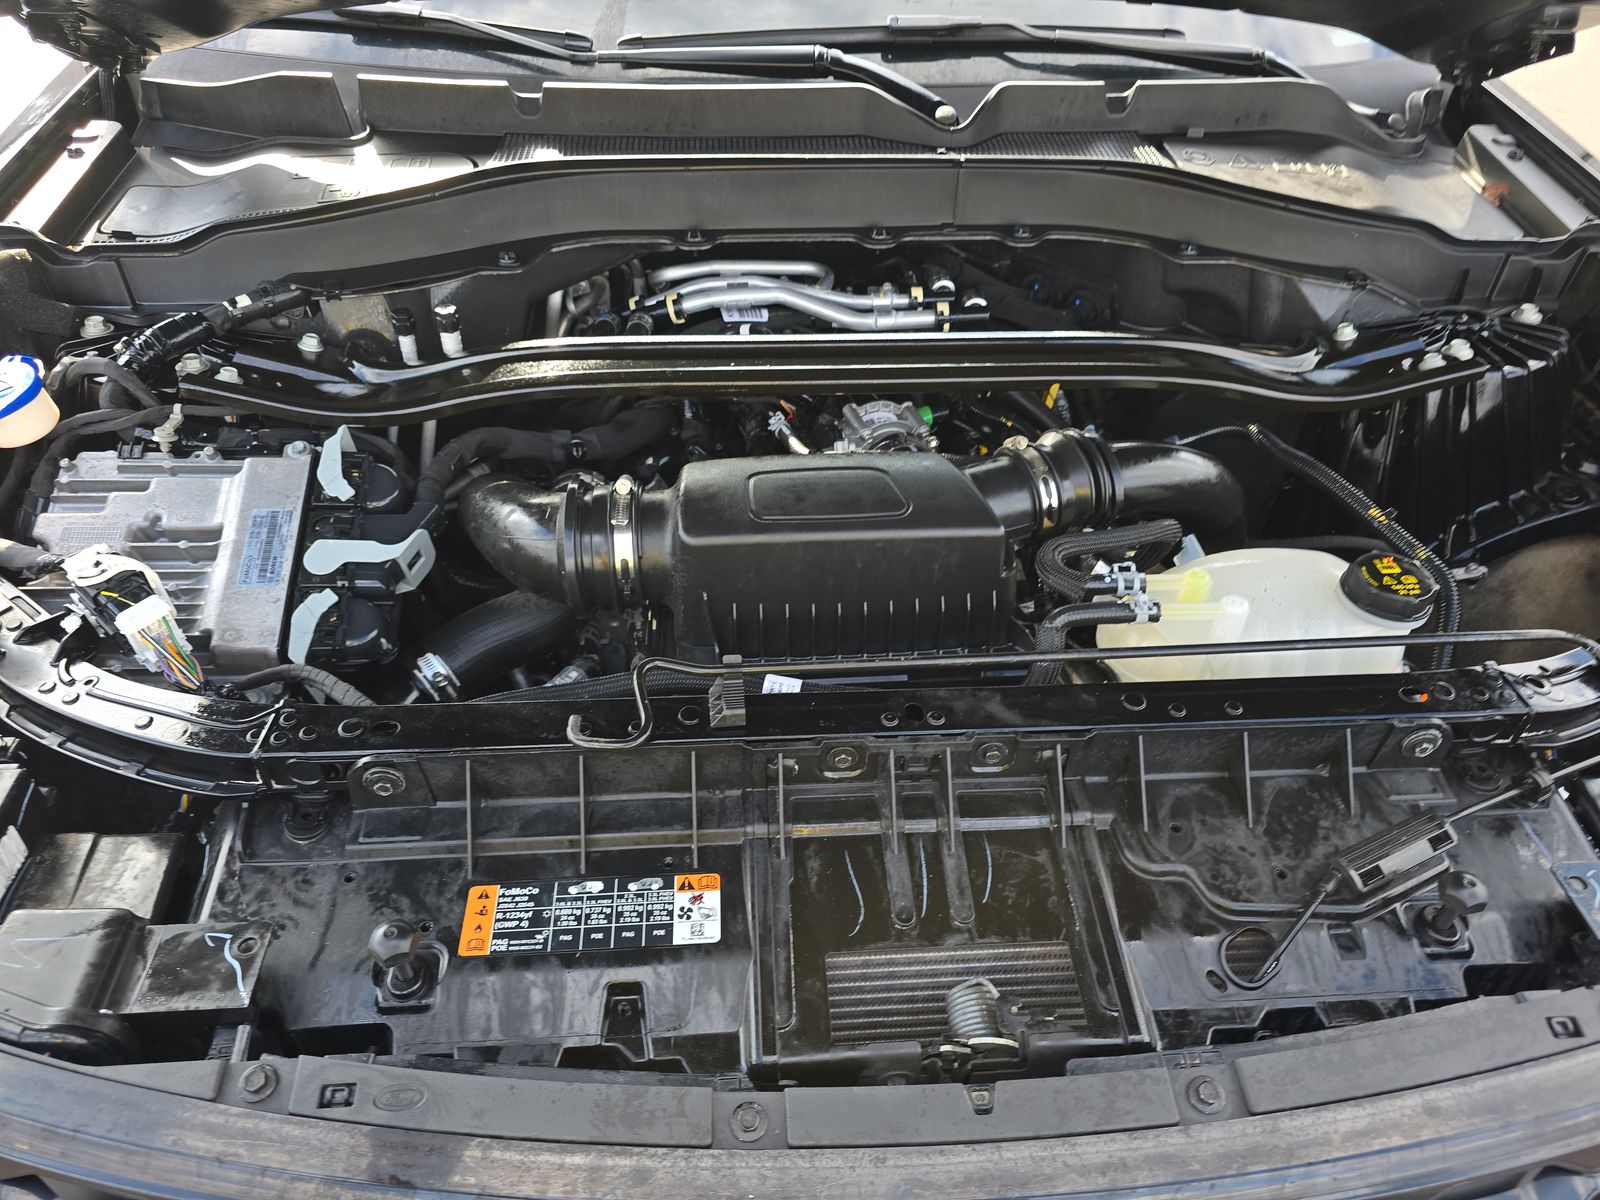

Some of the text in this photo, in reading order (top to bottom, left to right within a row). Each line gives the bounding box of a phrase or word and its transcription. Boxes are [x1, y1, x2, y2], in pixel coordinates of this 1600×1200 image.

[269, 556, 278, 574] BOSCH
[242, 558, 253, 583] FoMoCo
[499, 887, 540, 896] FoMoCo
[602, 906, 612, 914] kg
[634, 904, 644, 913] kg
[647, 903, 674, 911] 0.992 kg
[495, 910, 534, 920] R-1234yf
[573, 908, 582, 916] kg
[494, 920, 530, 930] (GWP 4)
[490, 944, 508, 952] POE
